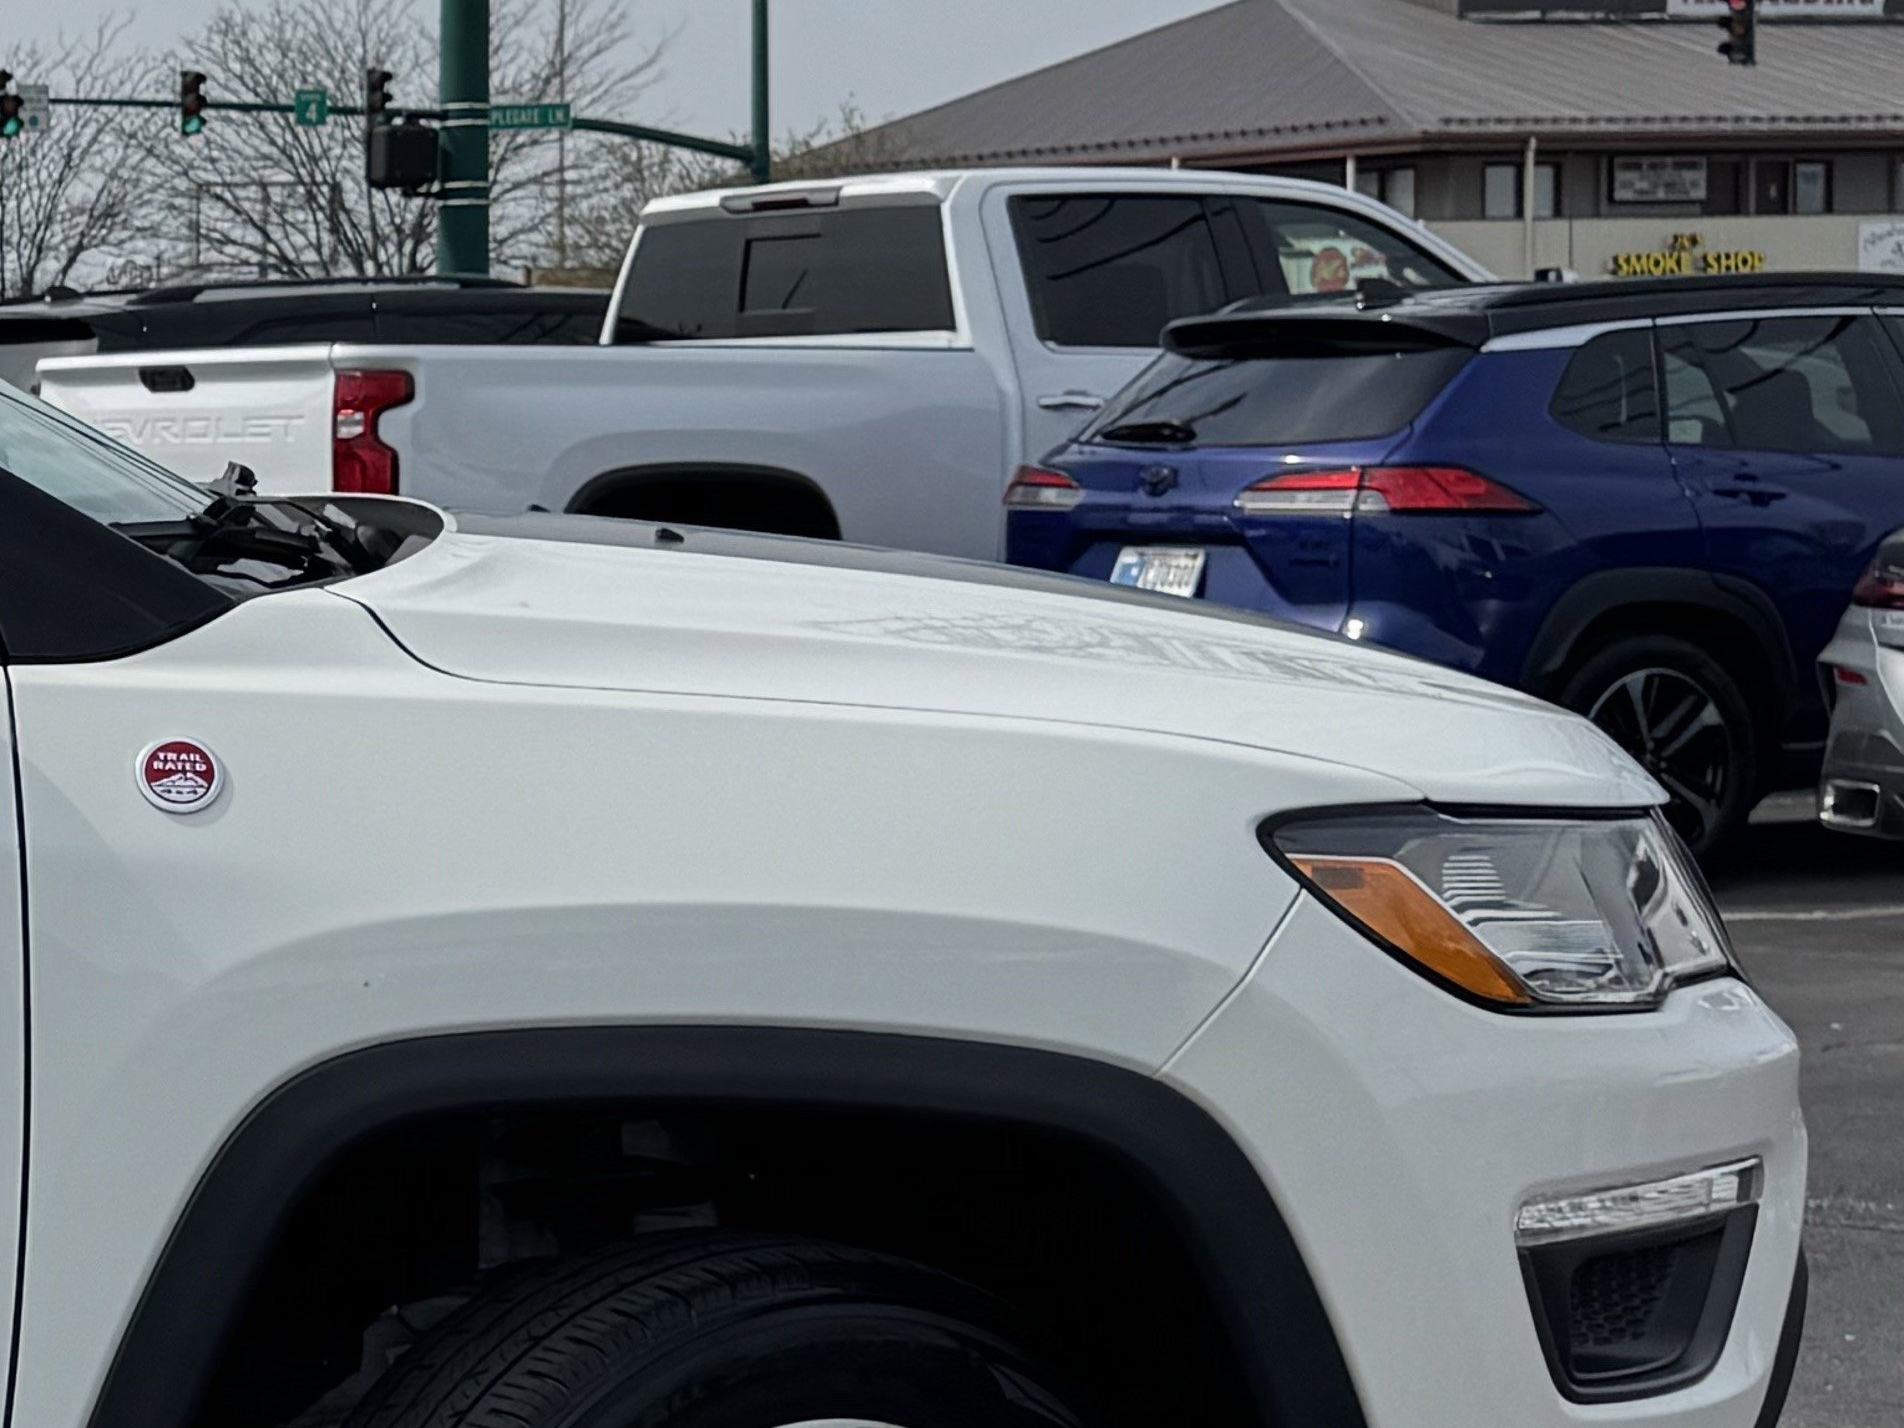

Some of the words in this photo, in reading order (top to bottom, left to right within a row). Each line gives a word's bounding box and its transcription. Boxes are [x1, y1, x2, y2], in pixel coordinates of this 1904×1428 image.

[1615, 252, 1691, 276] SMOKE
[1703, 251, 1766, 273] SHOP
[94, 415, 306, 444] EVROLET
[158, 752, 203, 761] TRAIL
[153, 761, 207, 771] RATED
